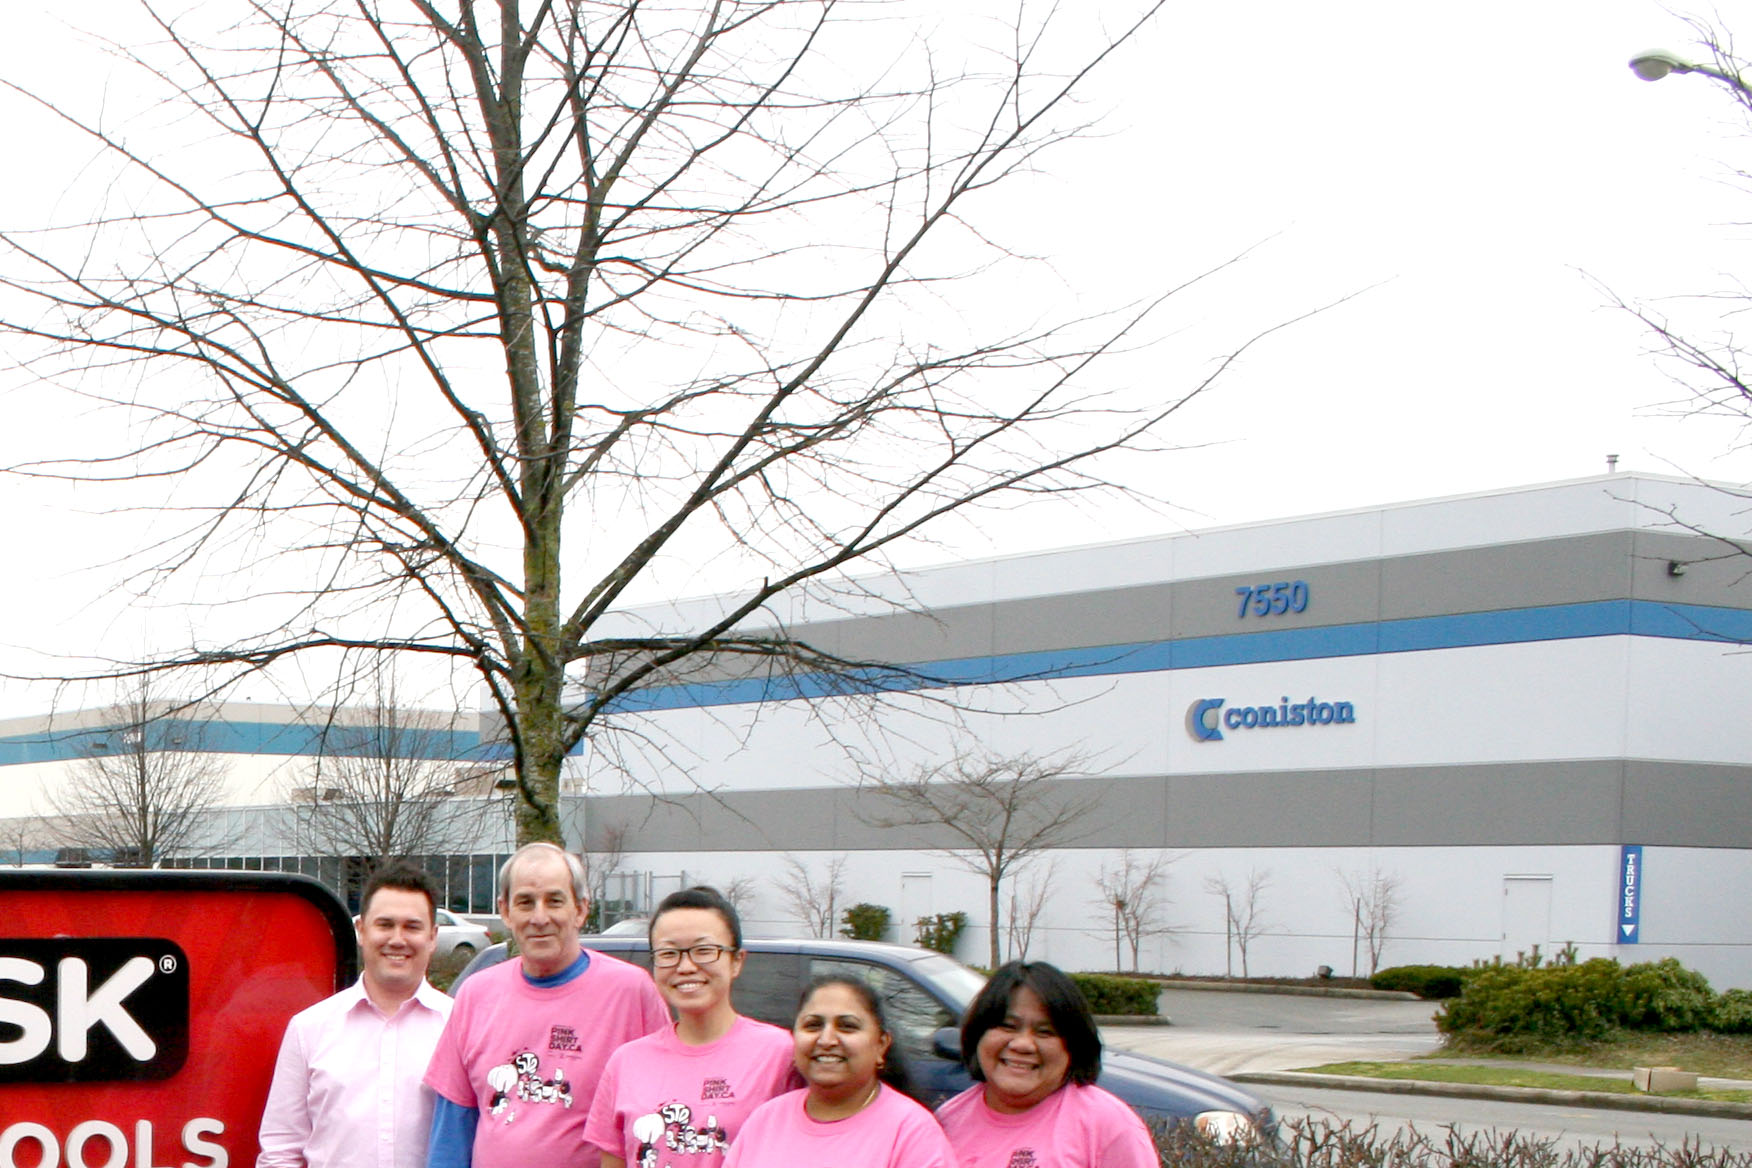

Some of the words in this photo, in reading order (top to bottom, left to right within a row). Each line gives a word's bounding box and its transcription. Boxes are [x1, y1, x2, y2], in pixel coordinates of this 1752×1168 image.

[1234, 580, 1309, 618] 7550
[1224, 695, 1355, 729] coniston
[1624, 853, 1636, 918] TRUCKS
